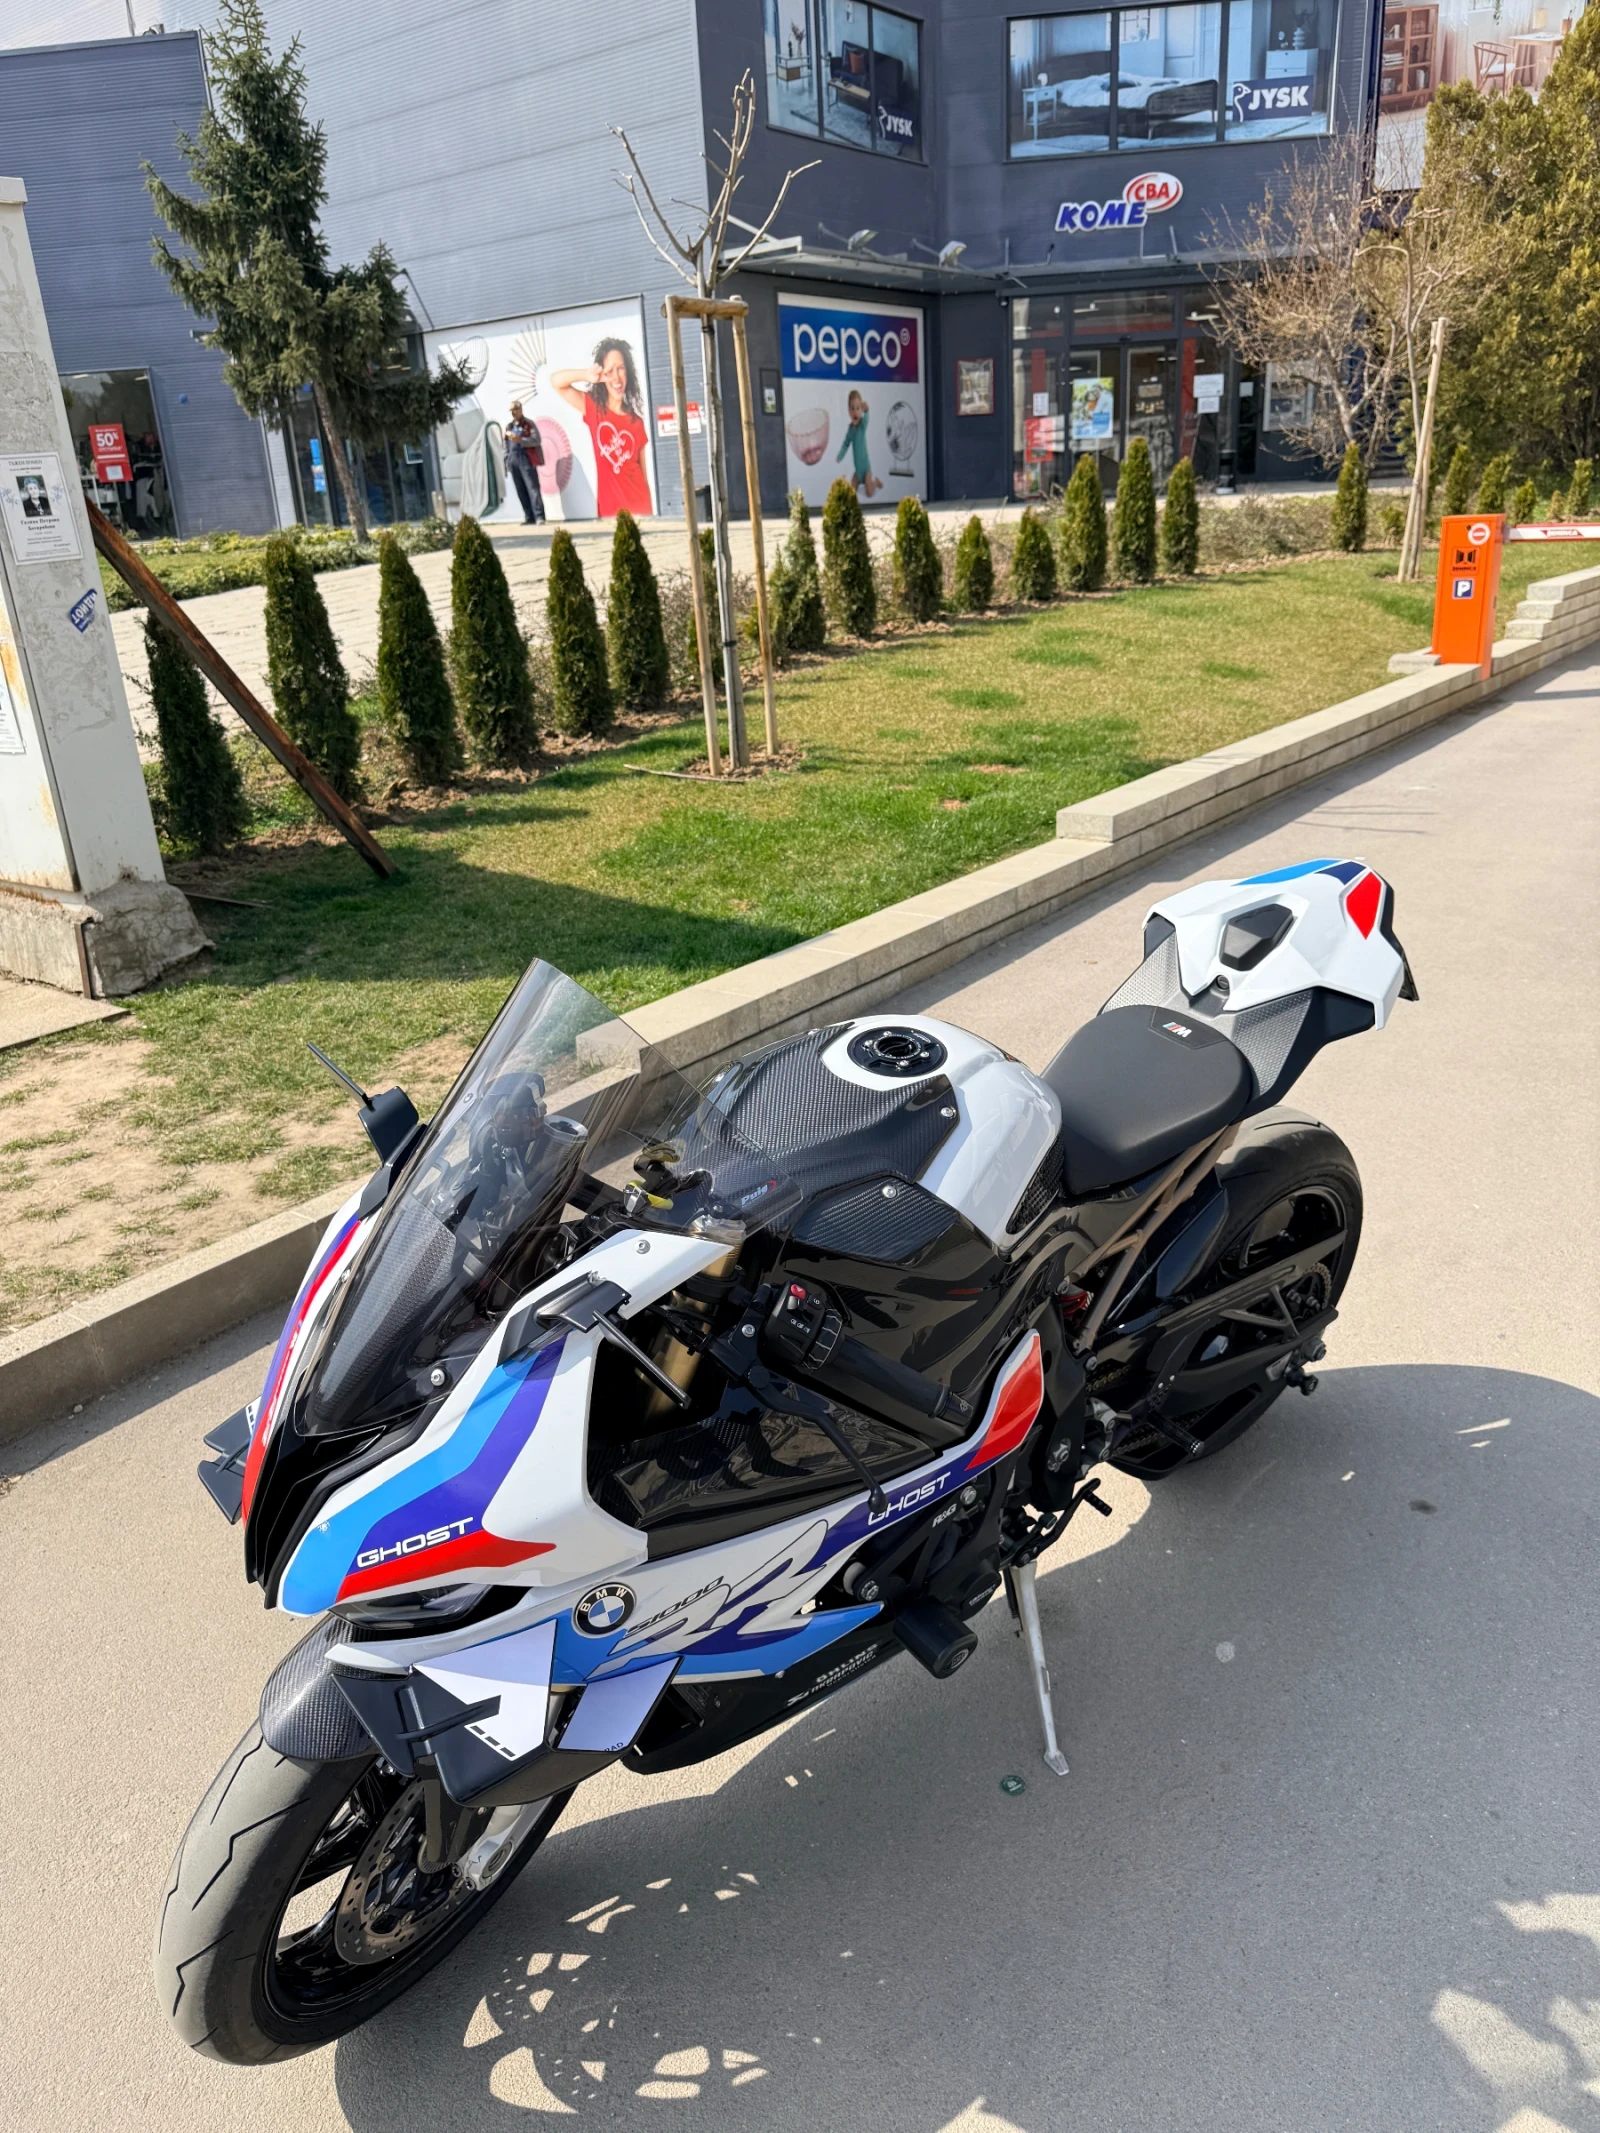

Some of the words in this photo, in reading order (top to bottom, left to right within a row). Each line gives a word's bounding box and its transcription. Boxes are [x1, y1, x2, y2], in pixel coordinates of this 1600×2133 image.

[1248, 86, 1309, 110] JYSK
[886, 115, 913, 137] JYSK
[1135, 182, 1170, 201] CBA
[793, 323, 901, 375] pepco
[95, 432, 119, 447] 50%
[1456, 580, 1471, 597] P
[741, 1184, 768, 1206] Puig
[868, 1471, 951, 1526] GHOST
[932, 1503, 957, 1528] R&G
[357, 1516, 474, 1568] GHOST
[580, 1586, 628, 1612] BMW
